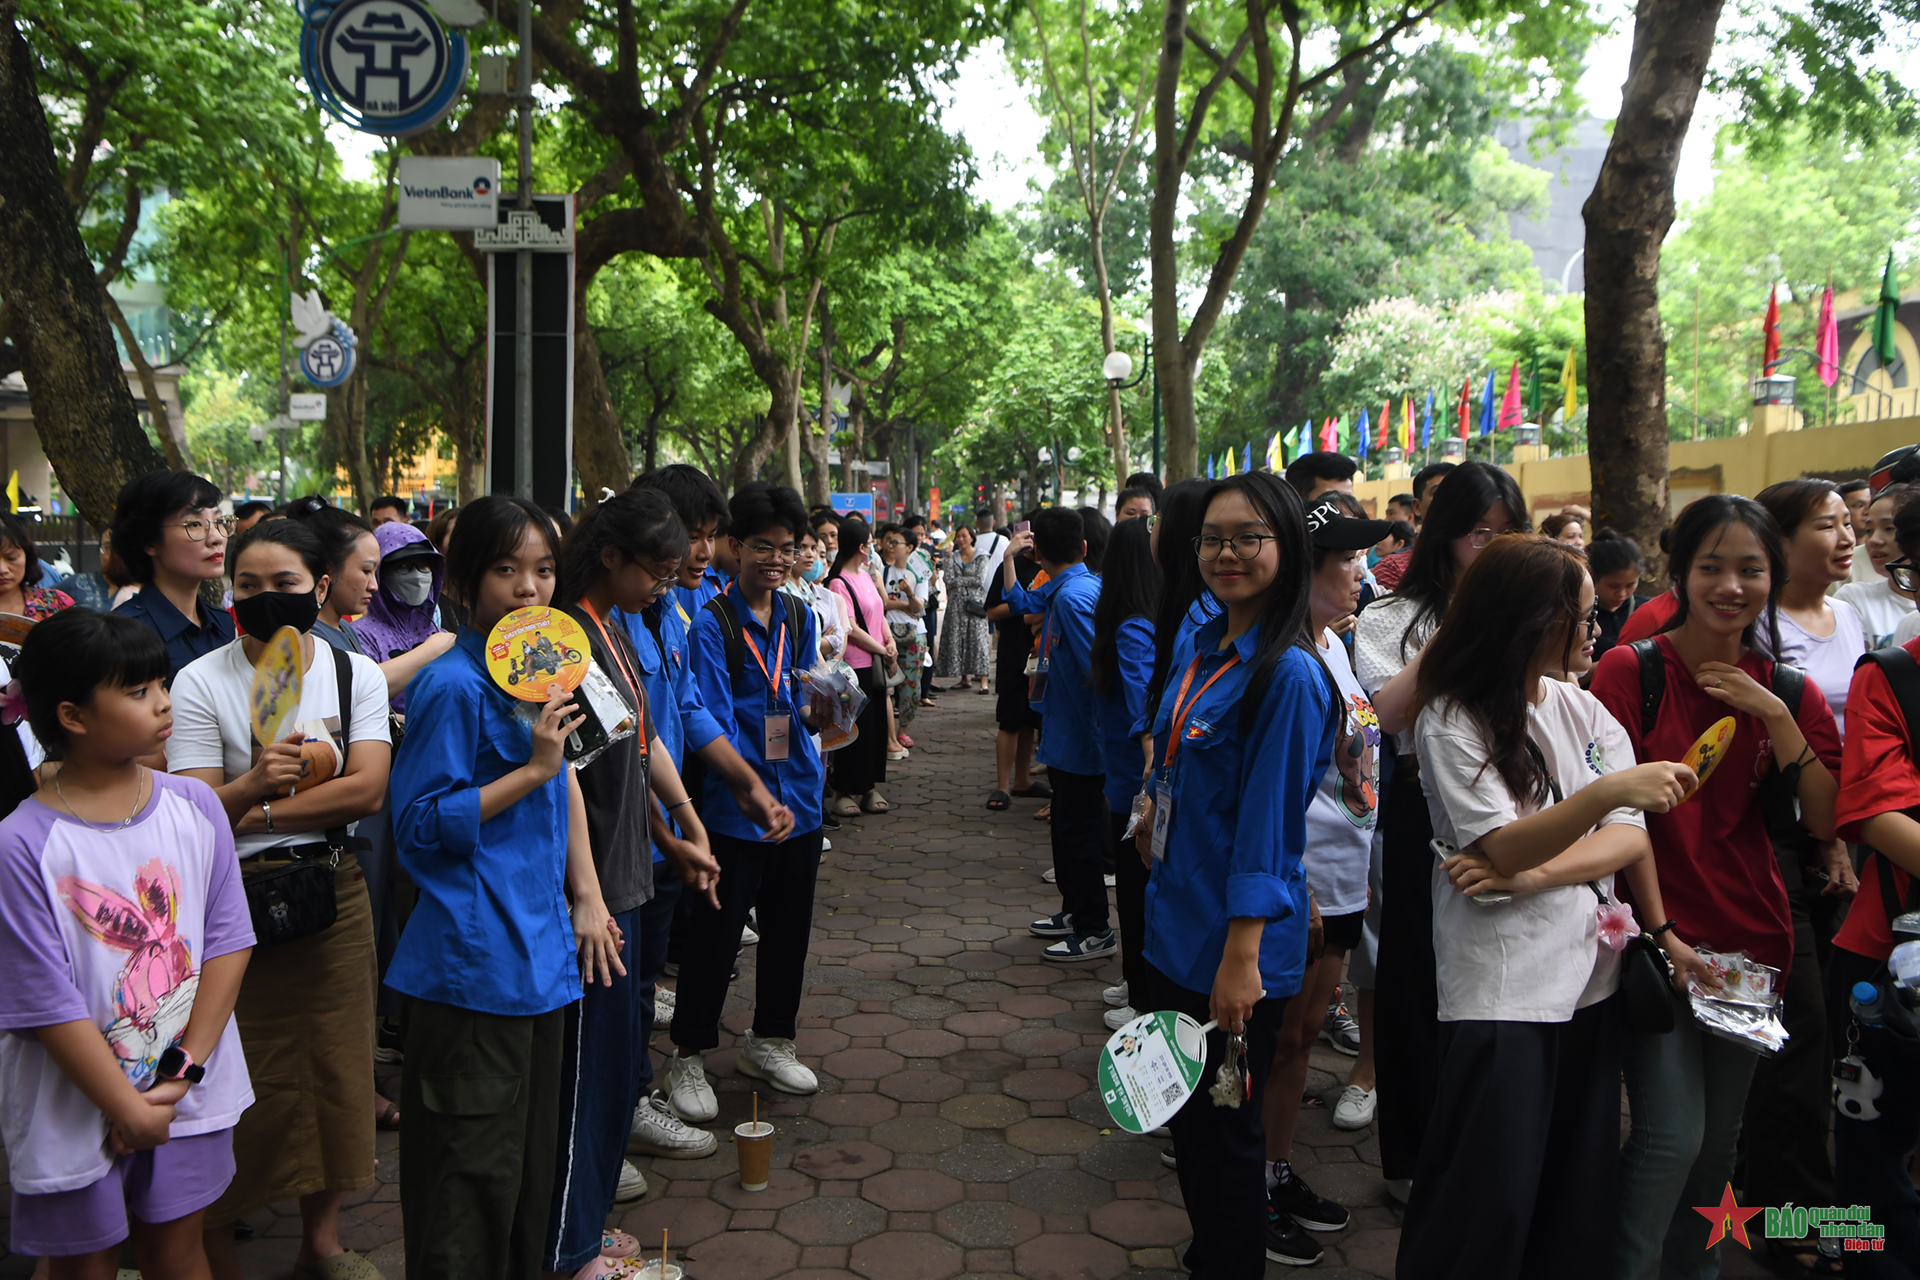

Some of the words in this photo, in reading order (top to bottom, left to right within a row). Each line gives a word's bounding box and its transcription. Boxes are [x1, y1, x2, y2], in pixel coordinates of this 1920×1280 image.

[404, 185, 474, 200] VietinBank
[1107, 1063, 1119, 1087] MOBILE
[1115, 1086, 1124, 1096] HÀ
[1120, 1095, 1133, 1117] HOÀNG
